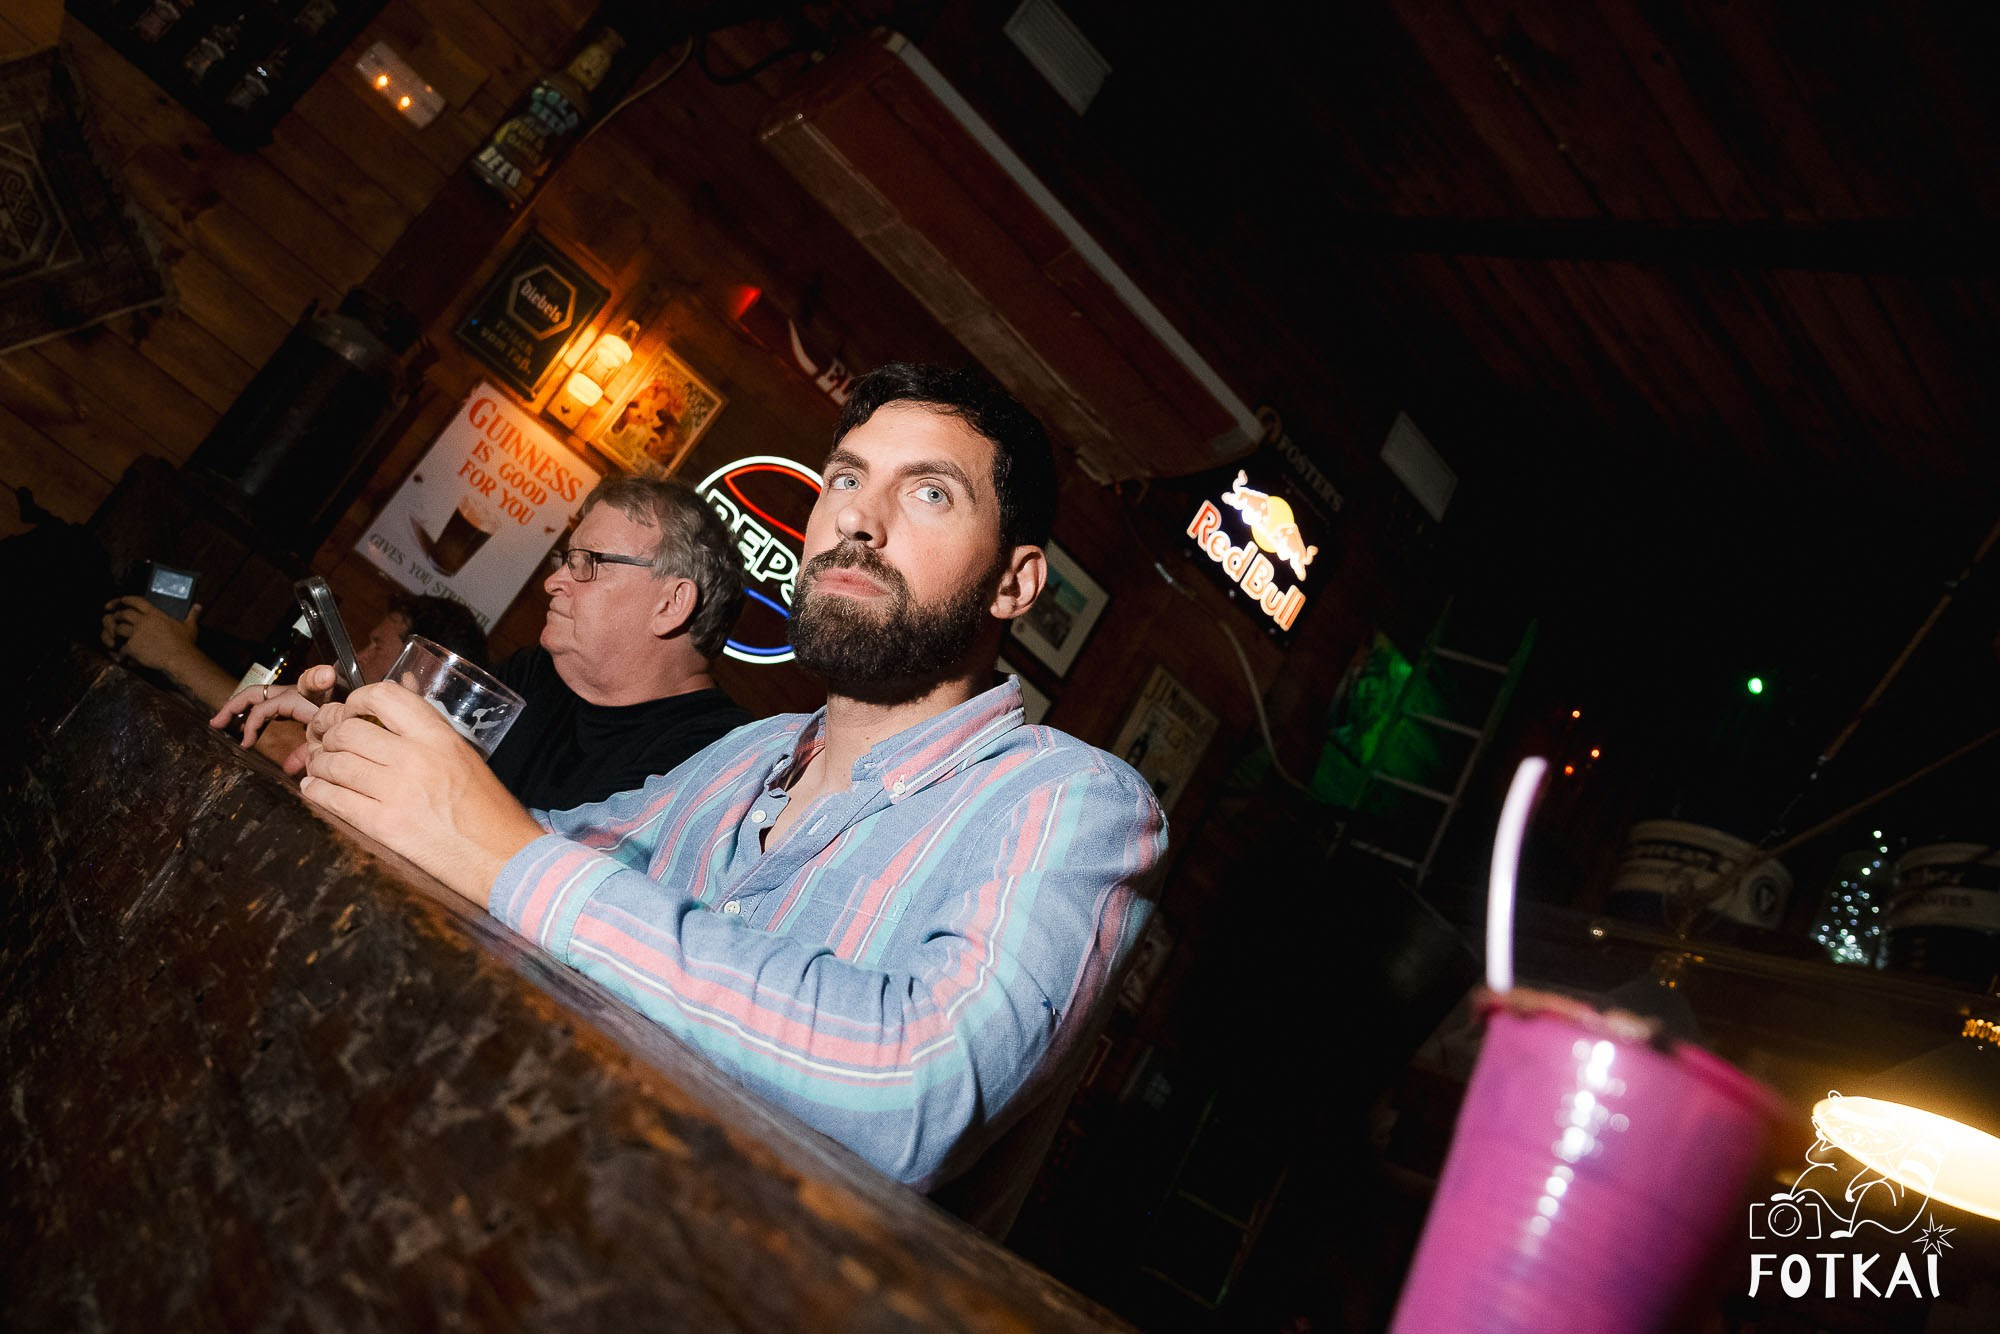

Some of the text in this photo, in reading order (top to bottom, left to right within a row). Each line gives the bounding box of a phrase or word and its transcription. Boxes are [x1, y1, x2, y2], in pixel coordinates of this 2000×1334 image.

[468, 397, 583, 503] GUINNESS
[471, 440, 548, 506] IS GOOD
[457, 459, 536, 526] FOR YOU
[369, 533, 405, 566] GIVES
[408, 562, 432, 586] YOU
